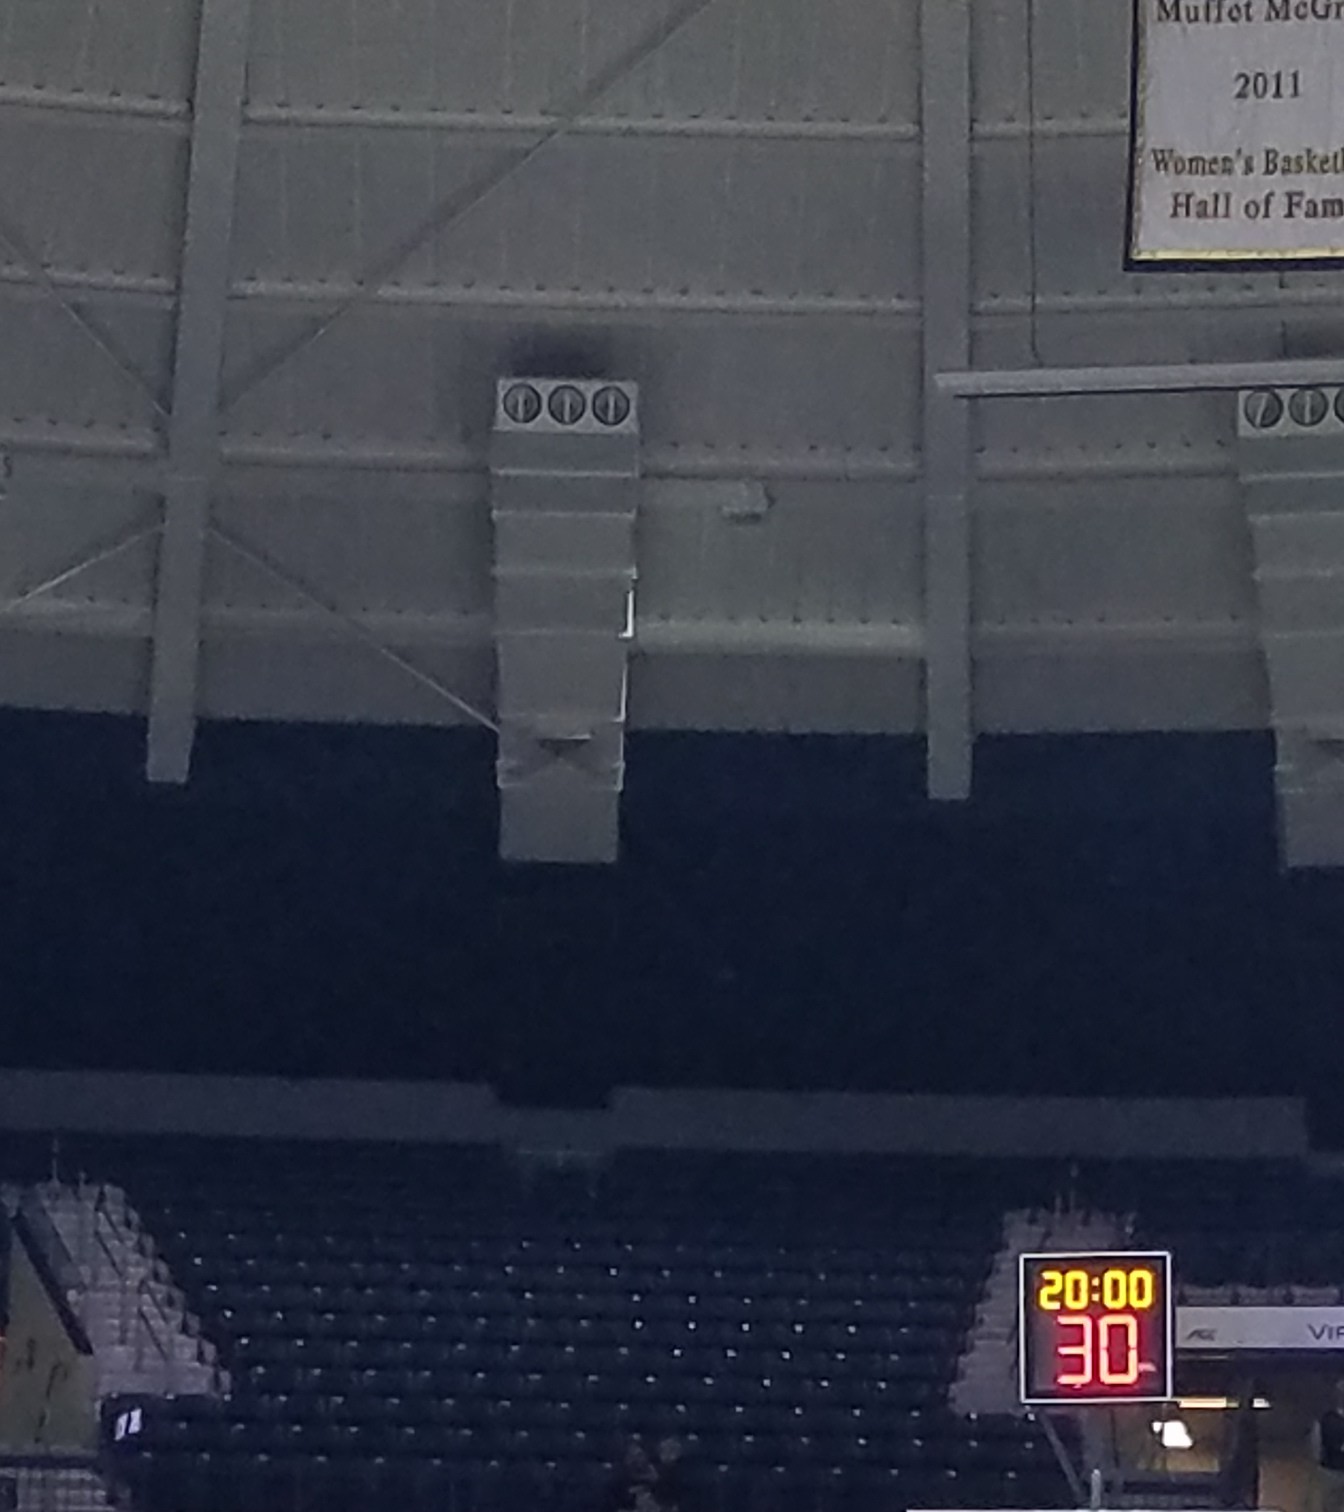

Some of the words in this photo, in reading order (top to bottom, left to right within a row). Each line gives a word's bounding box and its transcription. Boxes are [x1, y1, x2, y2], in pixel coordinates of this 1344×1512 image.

[1233, 70, 1301, 99] 2011
[1152, 147, 1254, 177] Women's
[1169, 192, 1232, 219] Hall
[1244, 191, 1275, 219] of
[1039, 1269, 1153, 1310] 20:00
[1057, 1314, 1140, 1385] 30
